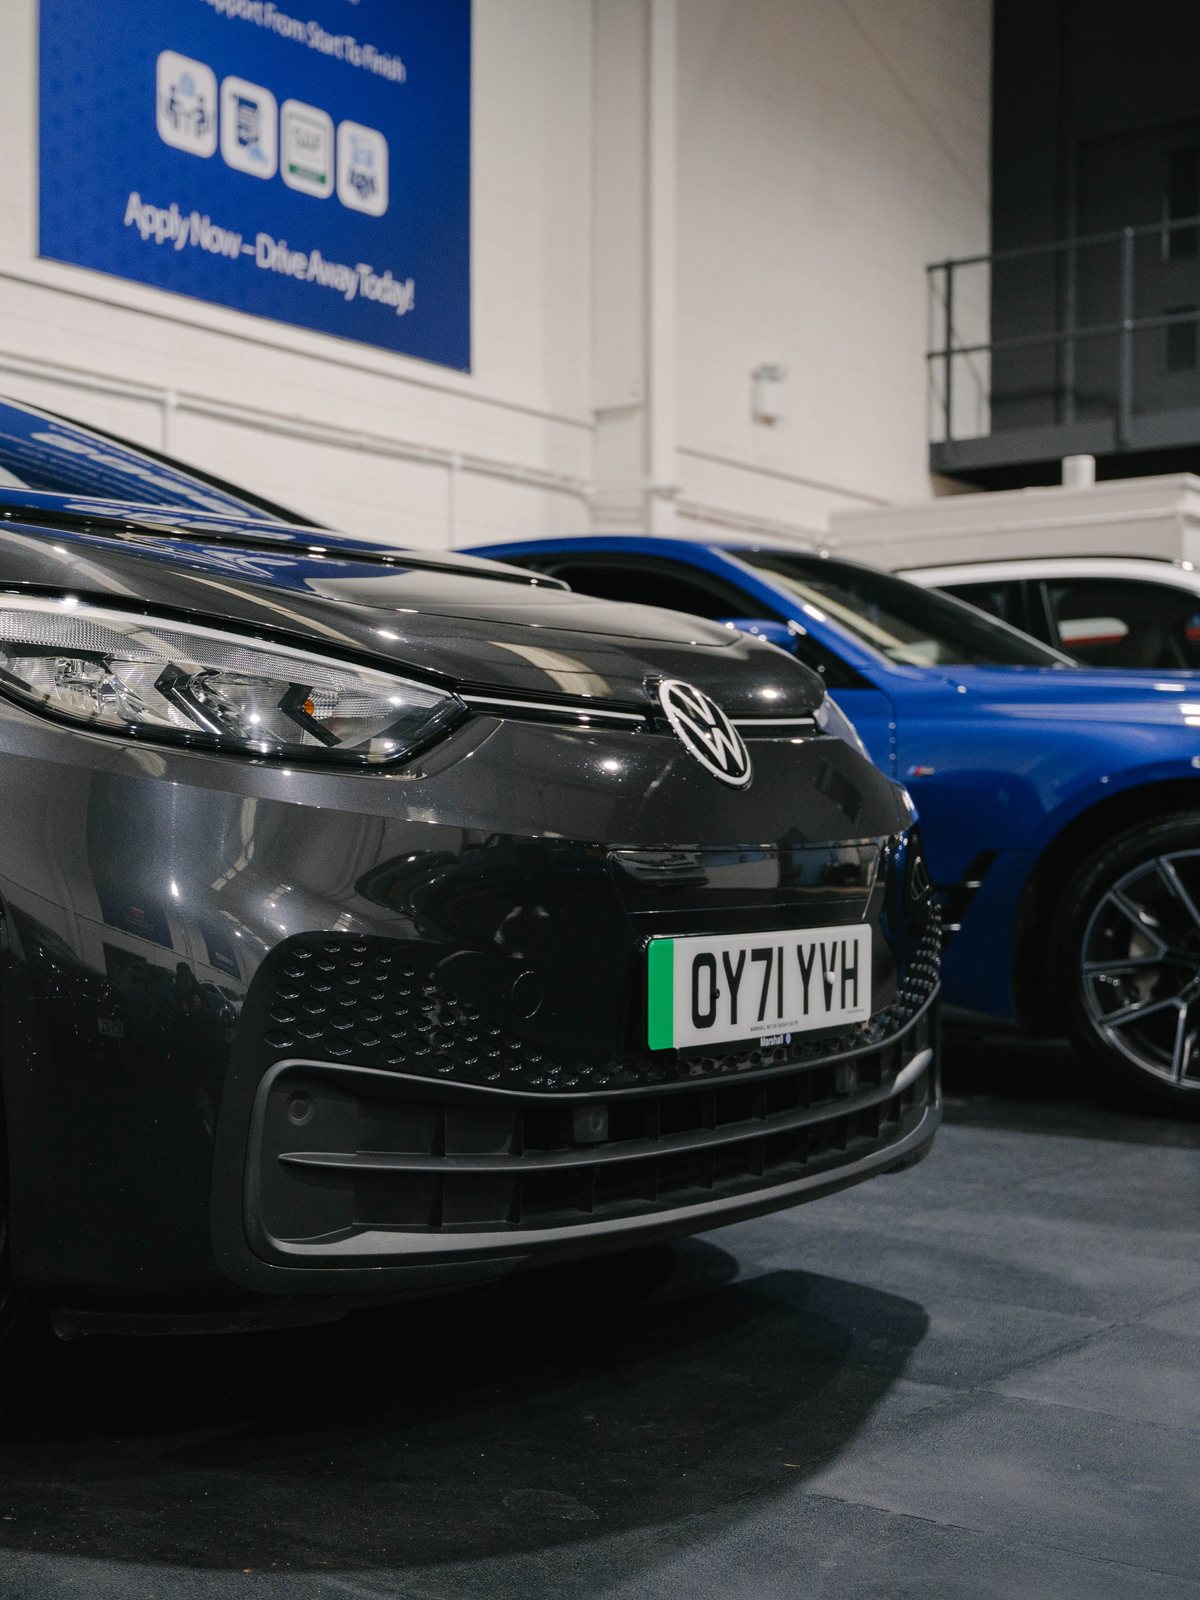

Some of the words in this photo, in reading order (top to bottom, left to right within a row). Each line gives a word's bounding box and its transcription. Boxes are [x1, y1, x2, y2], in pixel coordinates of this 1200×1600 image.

[264, 2, 306, 43] From
[306, 21, 344, 60] Start
[343, 35, 363, 67] To
[362, 43, 406, 84] Finish
[124, 191, 191, 251] Apply
[190, 211, 242, 259] Now
[256, 232, 308, 280] Drive
[307, 249, 360, 301] Away
[355, 262, 415, 316] Today!
[692, 946, 784, 1029] OY71
[797, 939, 858, 1015] YVH
[760, 1034, 784, 1047] Marshall
